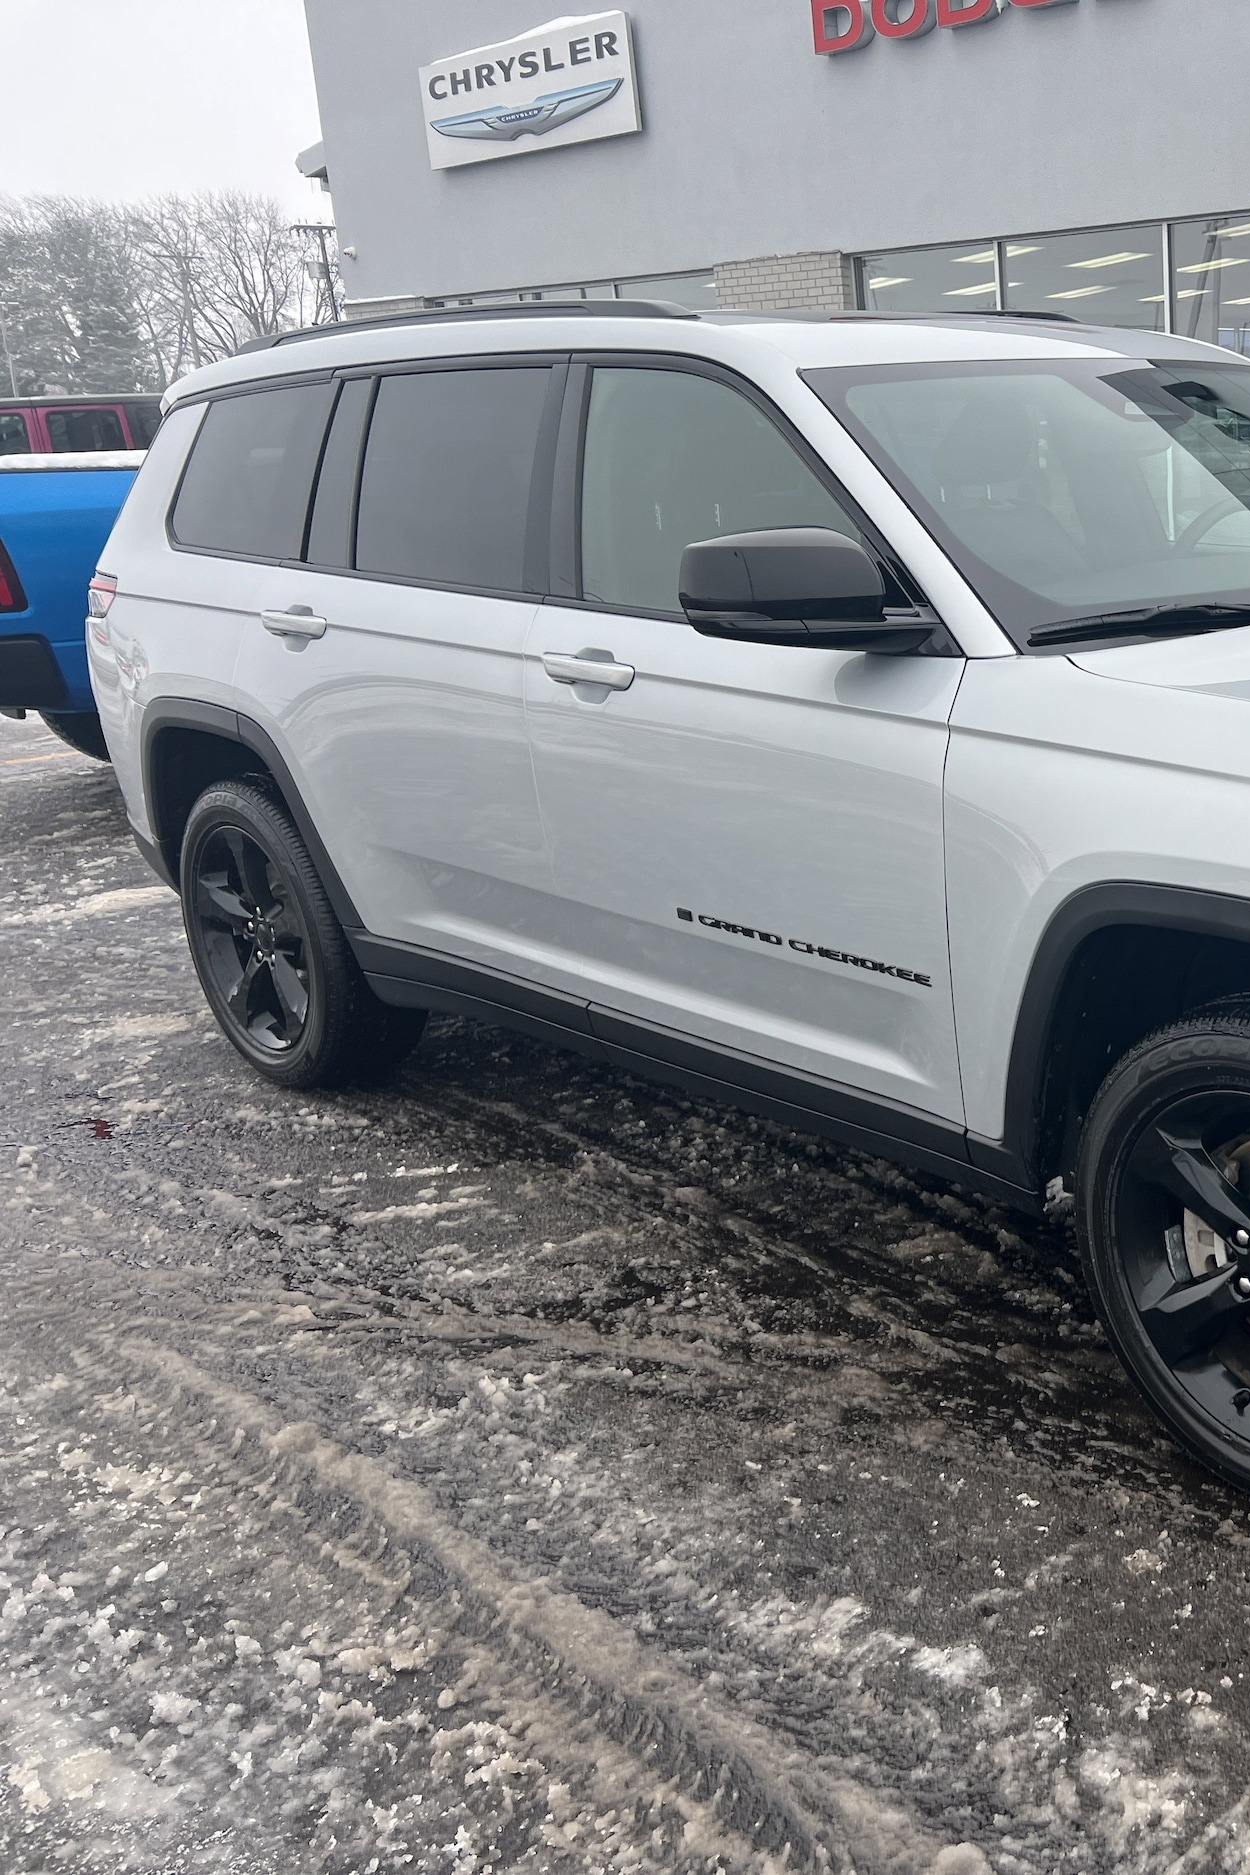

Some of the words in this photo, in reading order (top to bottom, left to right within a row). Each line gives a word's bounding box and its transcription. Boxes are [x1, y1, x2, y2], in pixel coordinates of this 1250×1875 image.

[428, 31, 619, 100] CHRYSLER
[501, 110, 539, 122] CHRYSLER
[698, 914, 783, 946] GRAND
[788, 938, 933, 988] CHEROKEE
